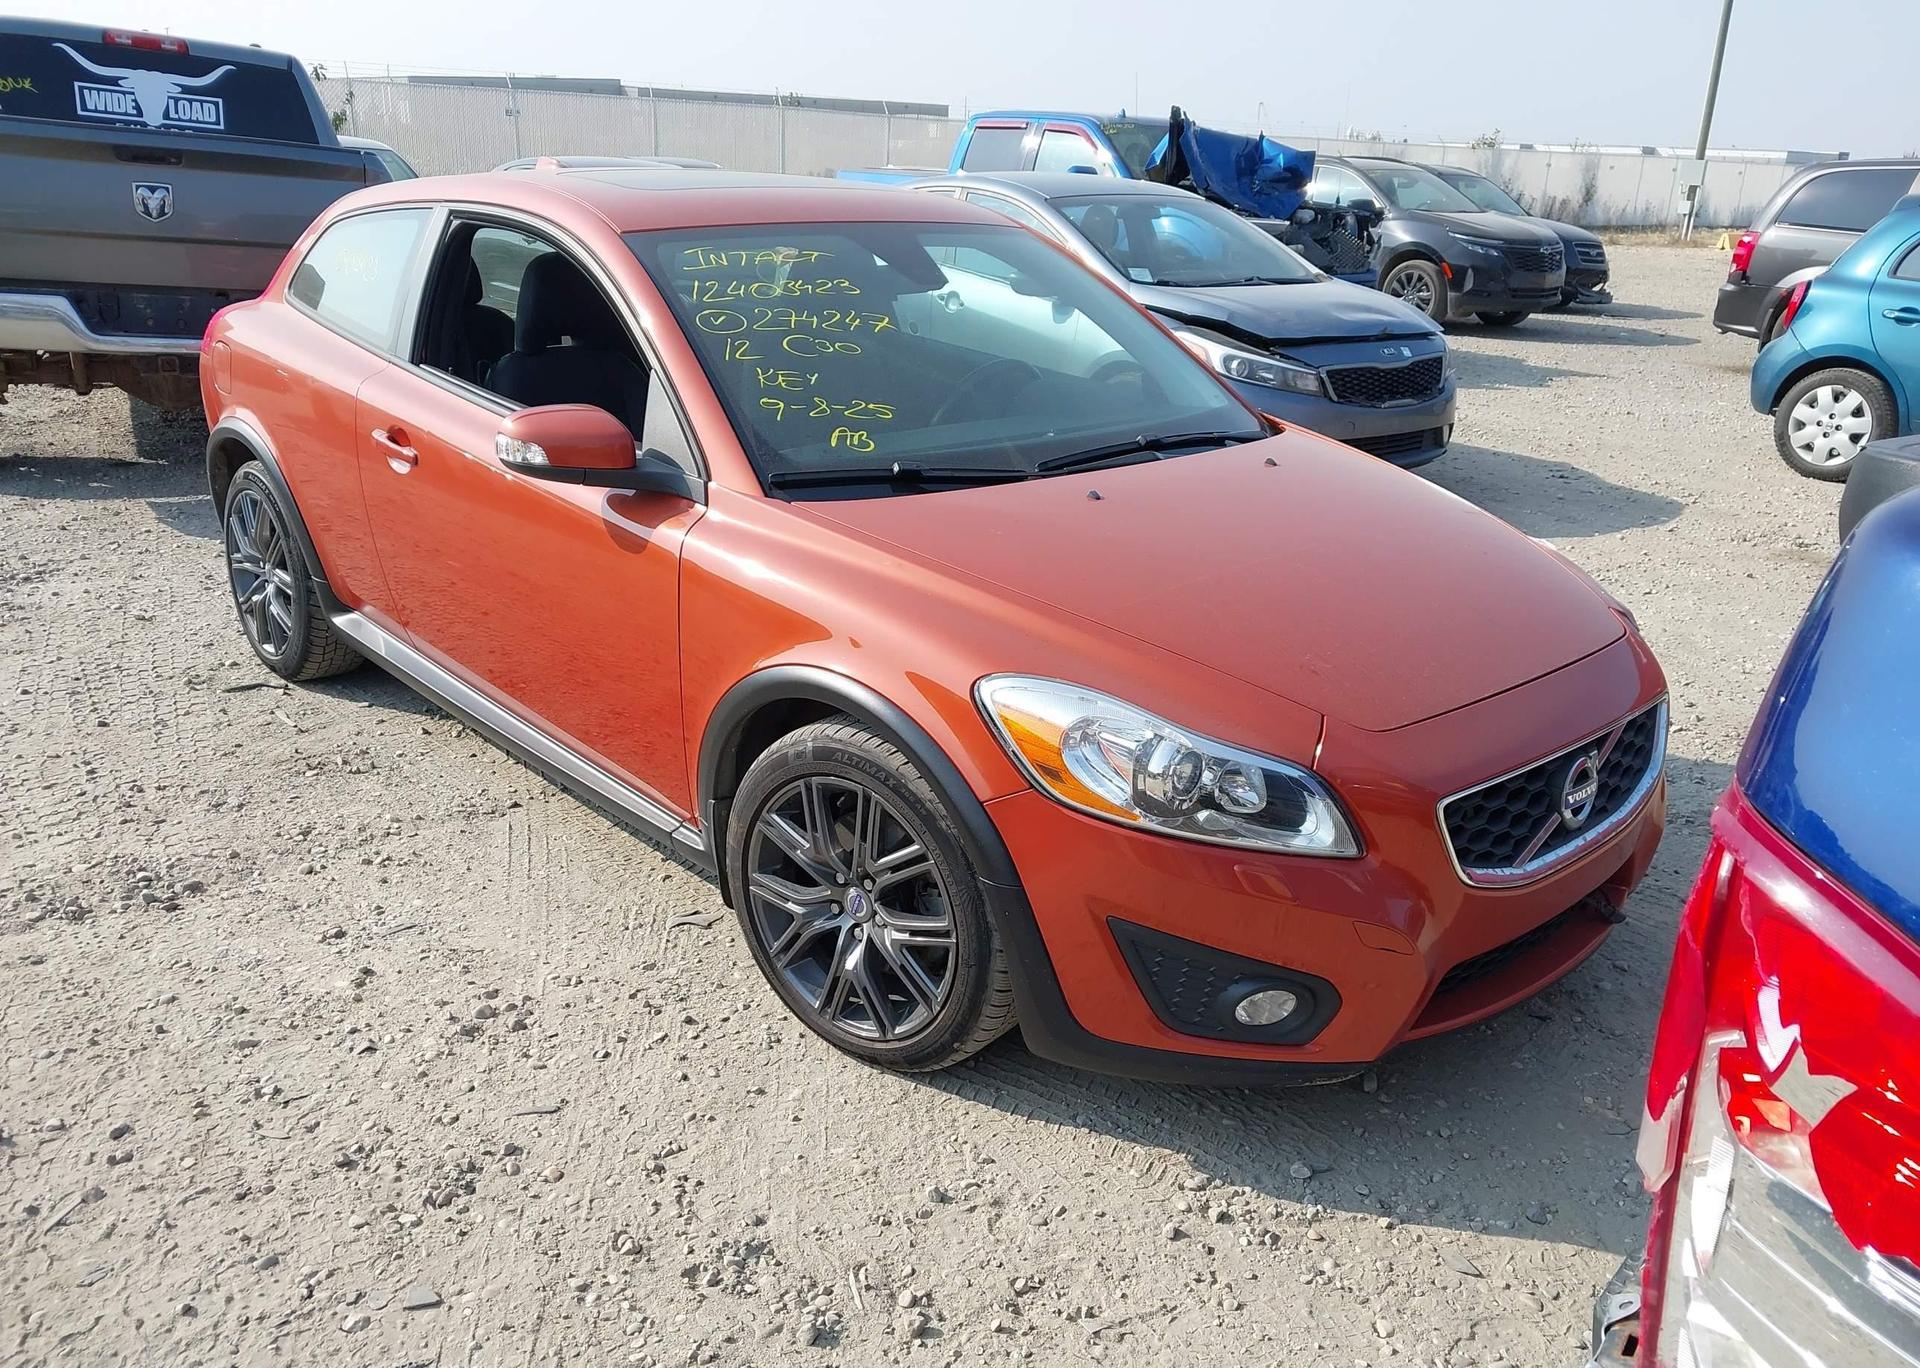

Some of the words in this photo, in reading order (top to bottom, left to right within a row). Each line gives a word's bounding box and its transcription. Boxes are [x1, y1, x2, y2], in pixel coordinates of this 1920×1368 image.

[83, 88, 137, 115] WIDE
[168, 98, 217, 122] LOAD
[683, 246, 836, 270] INTACT
[752, 307, 898, 333] 274247
[725, 337, 766, 361] 12
[782, 334, 862, 357] C30
[756, 367, 819, 390] KEY
[759, 397, 897, 421] 9-8-25
[830, 427, 875, 452] AB
[832, 750, 897, 789] ALTIMAX
